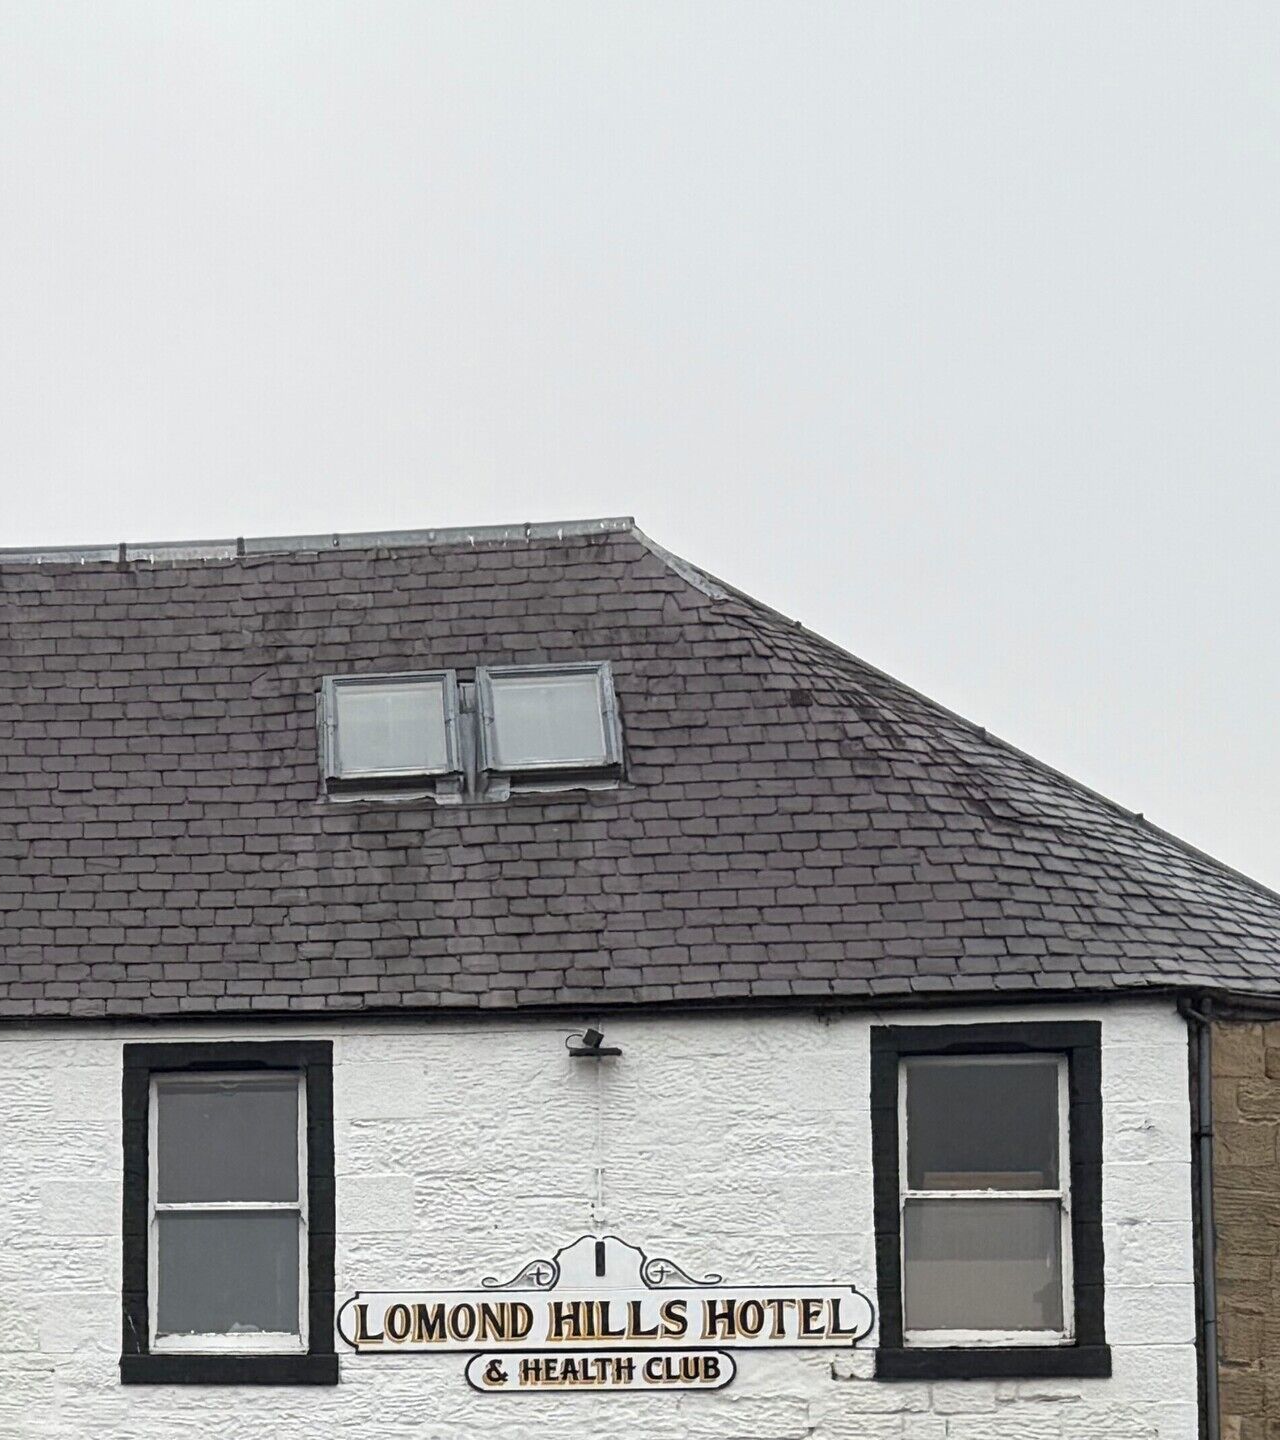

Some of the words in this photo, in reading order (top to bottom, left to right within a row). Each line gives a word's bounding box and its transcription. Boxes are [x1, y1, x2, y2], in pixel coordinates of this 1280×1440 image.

[354, 1302, 533, 1343] LOMOND
[546, 1300, 687, 1341] HILLS
[701, 1298, 857, 1340] HOTEL
[483, 1359, 508, 1386] &
[519, 1357, 636, 1385] HEALTH
[643, 1356, 721, 1384] CLUB
